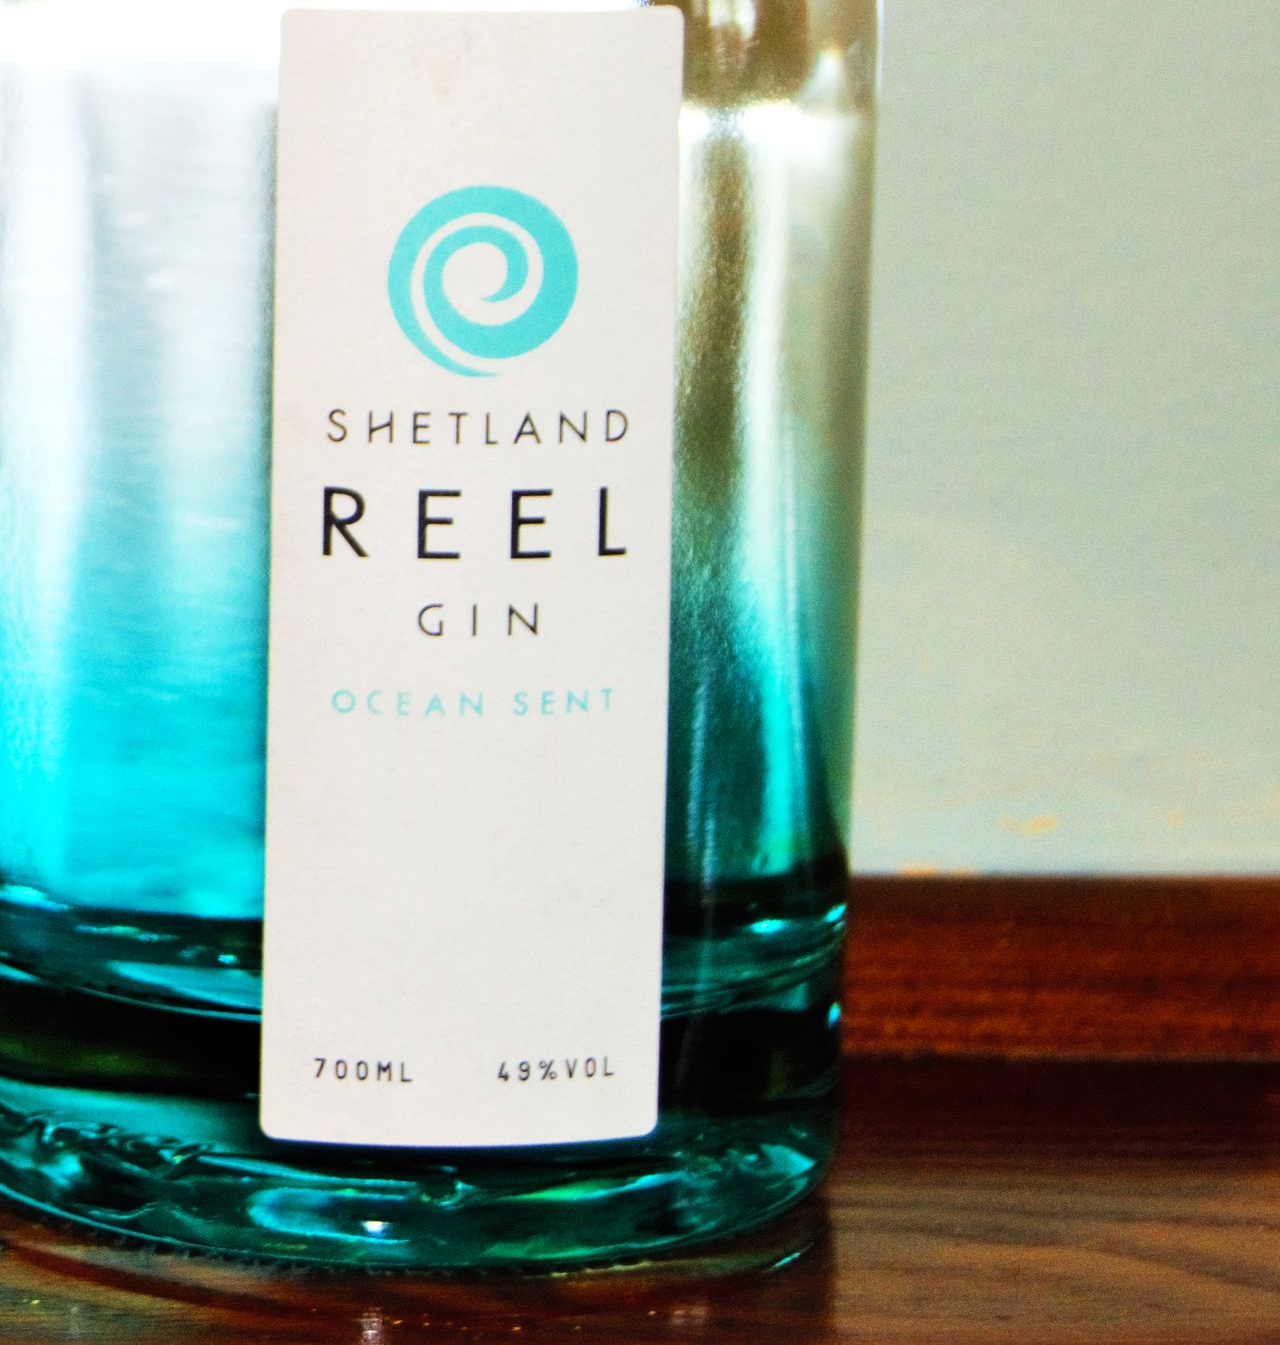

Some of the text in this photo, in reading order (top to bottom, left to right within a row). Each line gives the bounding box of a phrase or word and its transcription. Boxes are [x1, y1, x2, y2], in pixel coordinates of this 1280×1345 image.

[326, 409, 629, 445] SHETLAND
[322, 486, 627, 560] REEL
[417, 603, 539, 637] GIN
[331, 688, 614, 717] OCEAN SENT
[314, 1056, 615, 1083] 700ML 49%VOL
